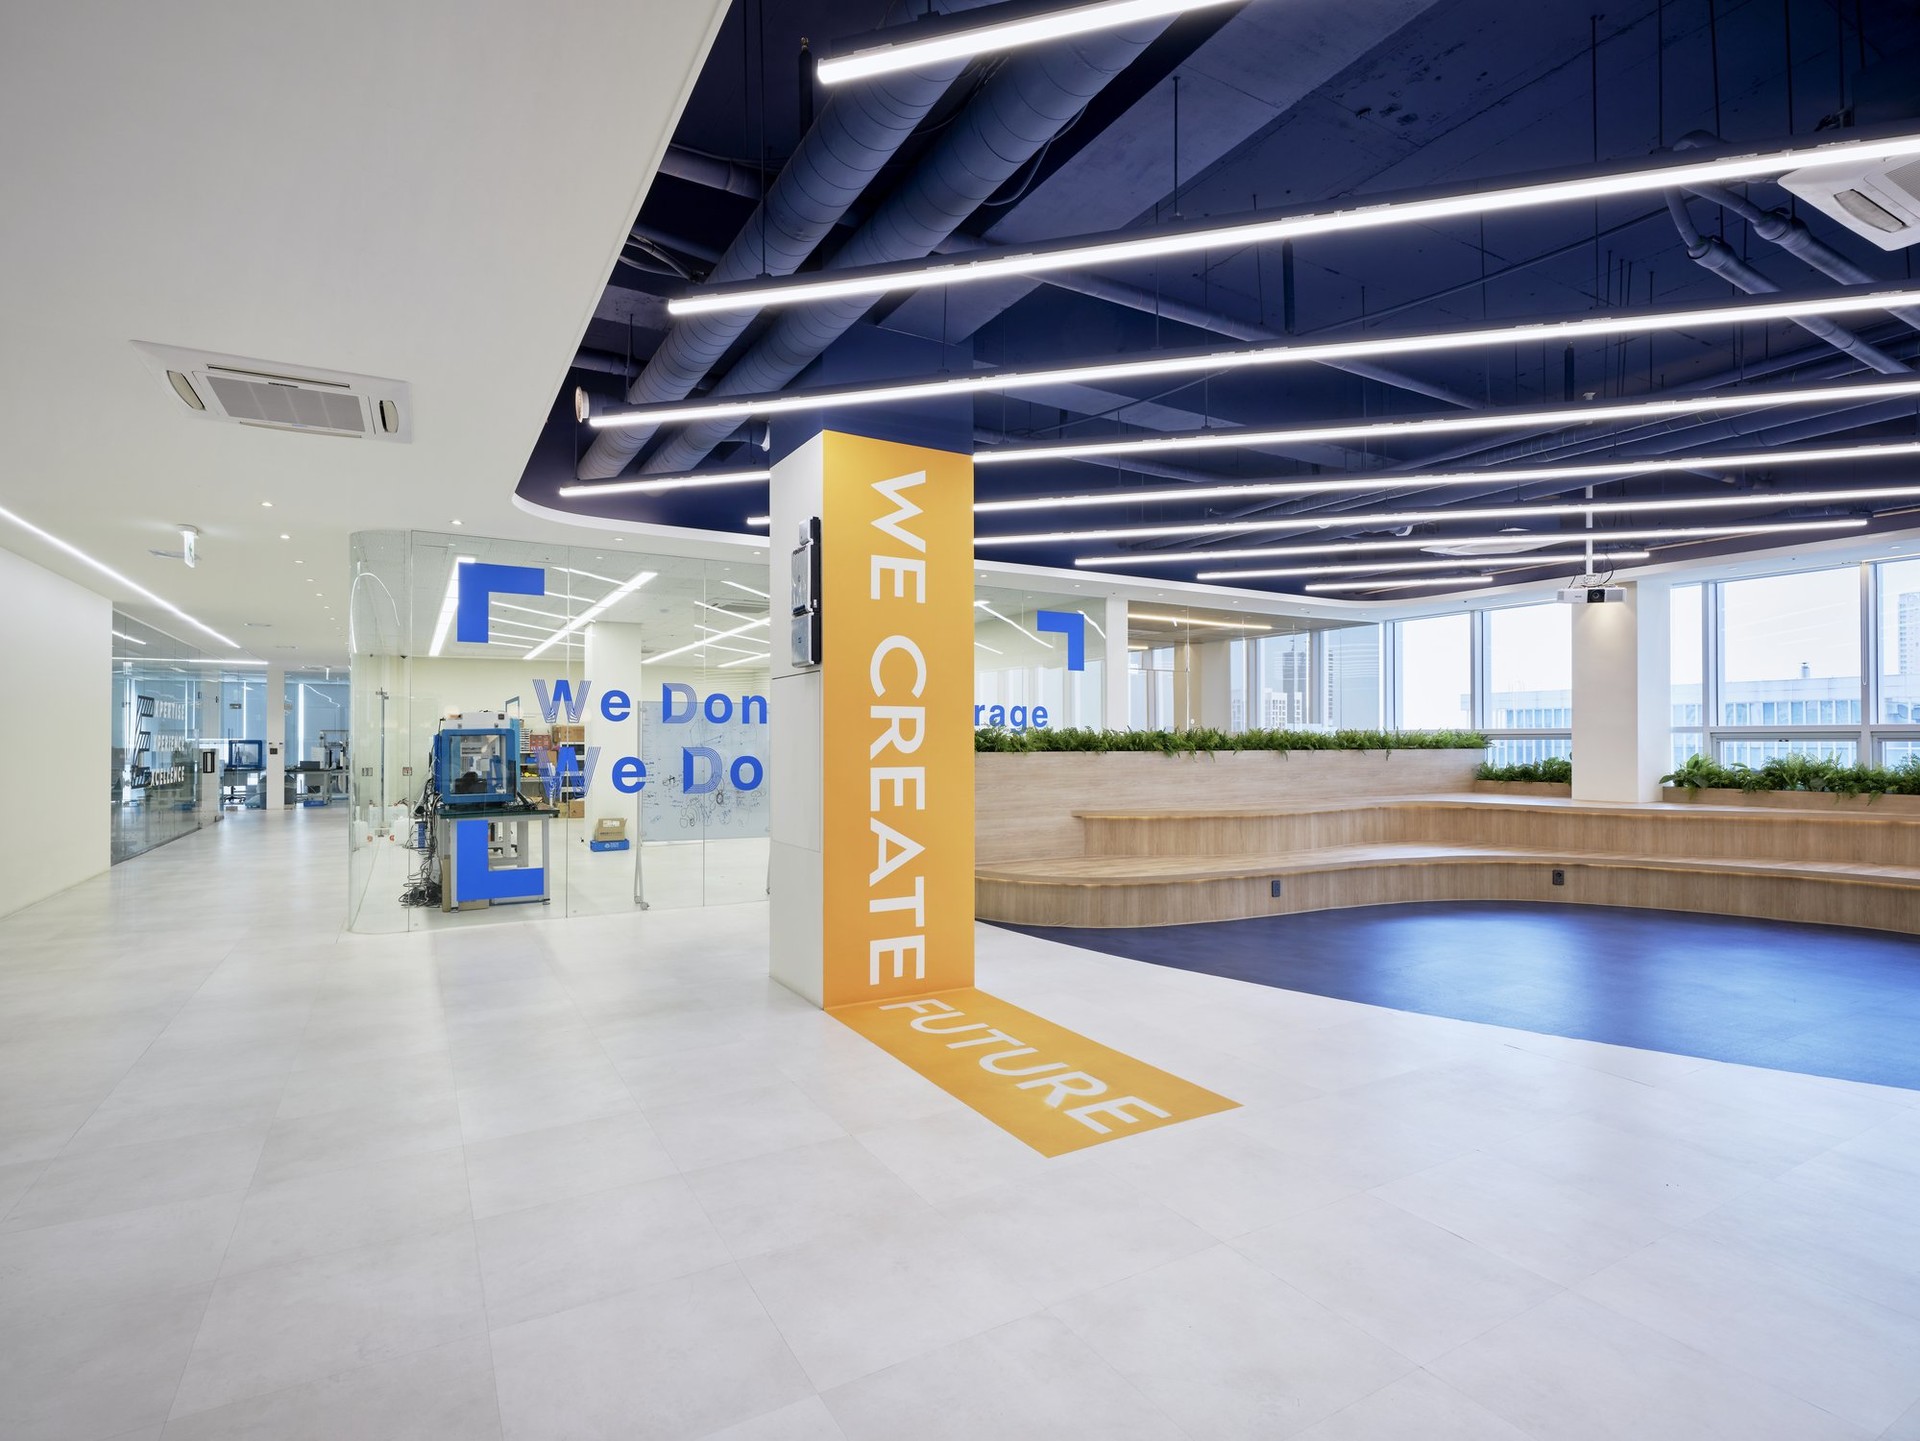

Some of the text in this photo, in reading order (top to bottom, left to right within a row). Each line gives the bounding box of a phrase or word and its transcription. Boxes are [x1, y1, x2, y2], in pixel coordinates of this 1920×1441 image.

[532, 679, 768, 725] We Don
[869, 470, 927, 986] WE CREATE
[974, 703, 1049, 735] rage
[533, 746, 647, 798] We
[682, 746, 764, 795] Do
[878, 998, 1173, 1135] FUTURE
